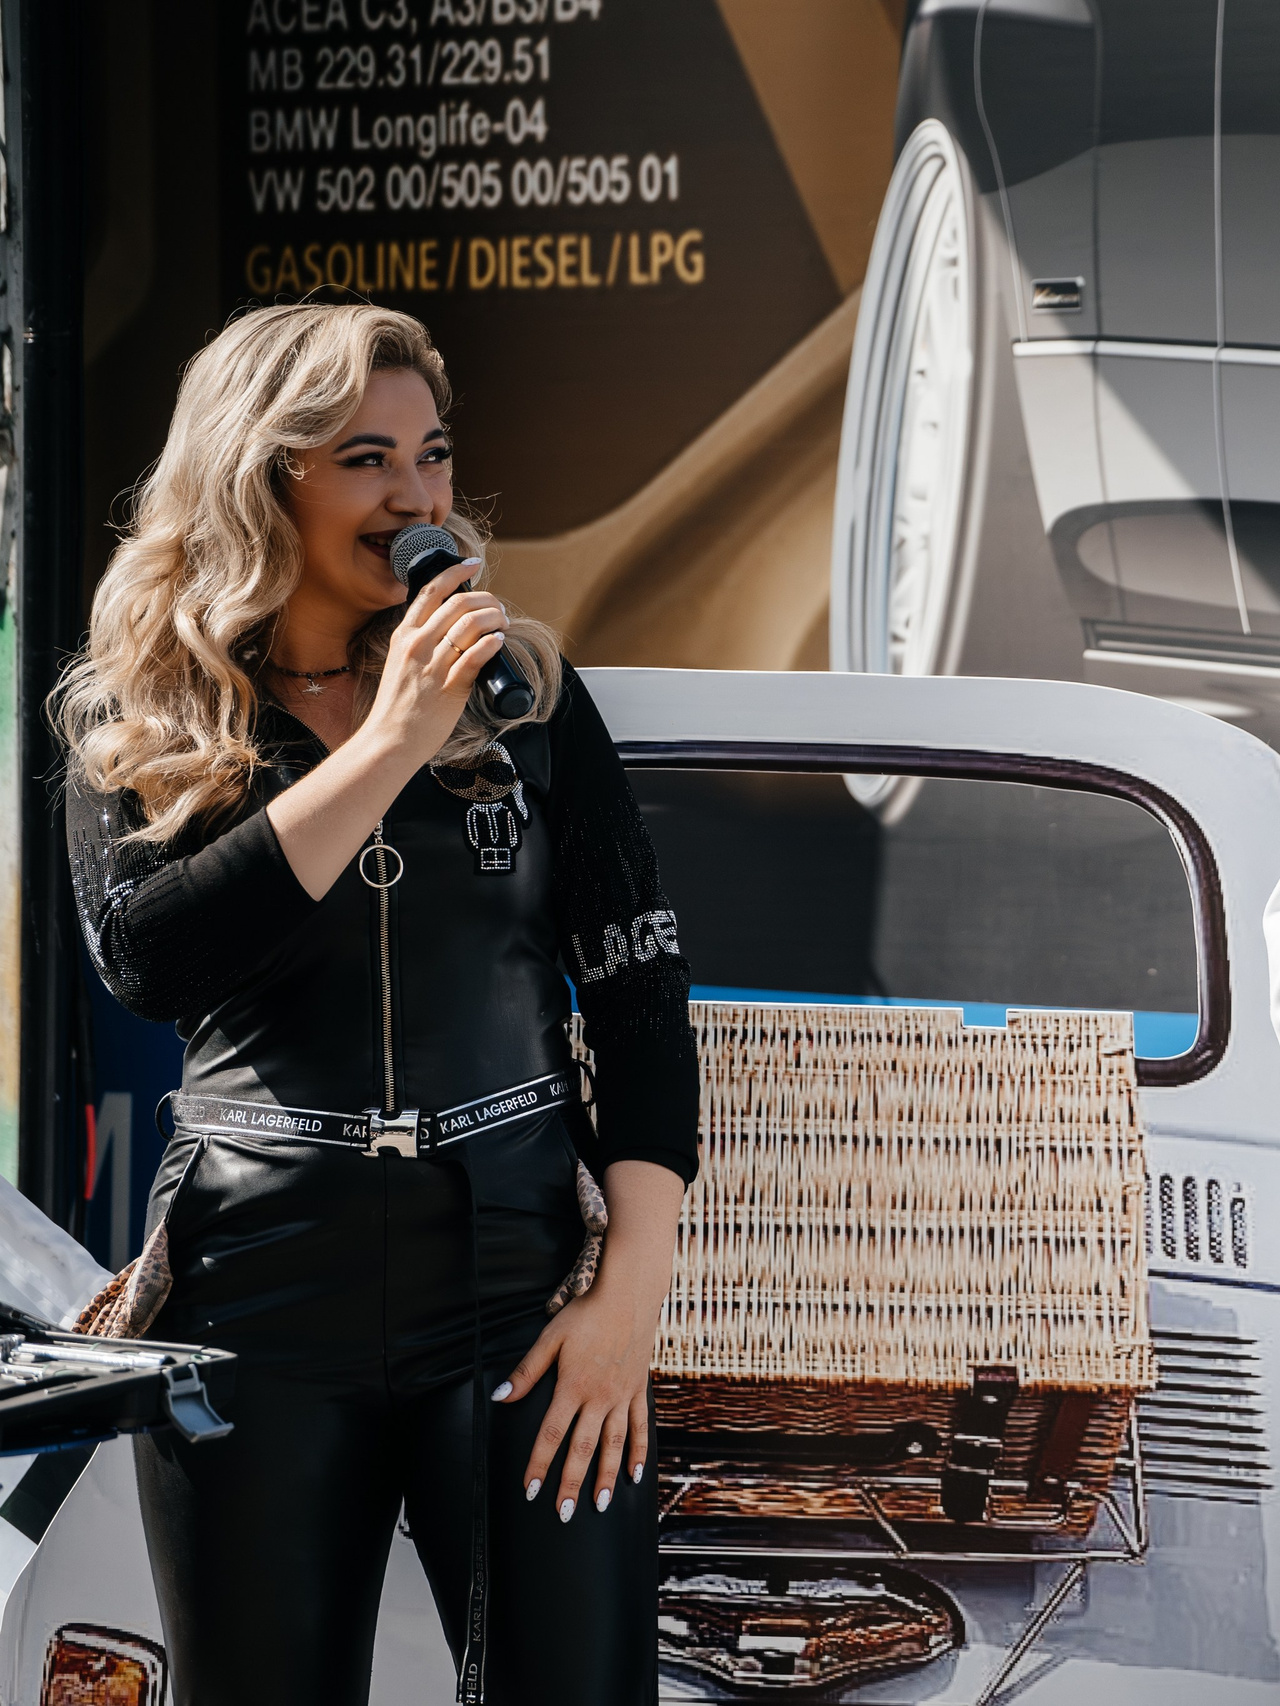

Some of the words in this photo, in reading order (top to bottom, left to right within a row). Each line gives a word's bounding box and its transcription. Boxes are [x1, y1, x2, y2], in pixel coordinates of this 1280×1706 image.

[248, 0, 349, 34] ACEA
[360, 0, 418, 36] C3,
[249, 48, 304, 92] MB
[316, 37, 550, 90] 229.31/229.51
[250, 106, 339, 152] BMW
[351, 97, 549, 159] Longlife-04
[249, 167, 304, 213] VW
[316, 164, 376, 213] 502
[386, 161, 503, 210] 00/505
[511, 154, 631, 207] 00/505
[638, 152, 679, 203] 01
[219, 1108, 248, 1124] KARL
[250, 1113, 323, 1132] LAGERFELD
[439, 1113, 475, 1135] KARL
[475, 1091, 538, 1123] LAGERFELD
[474, 1518, 485, 1600] LAGERFELD
[472, 1604, 483, 1643] KARL
